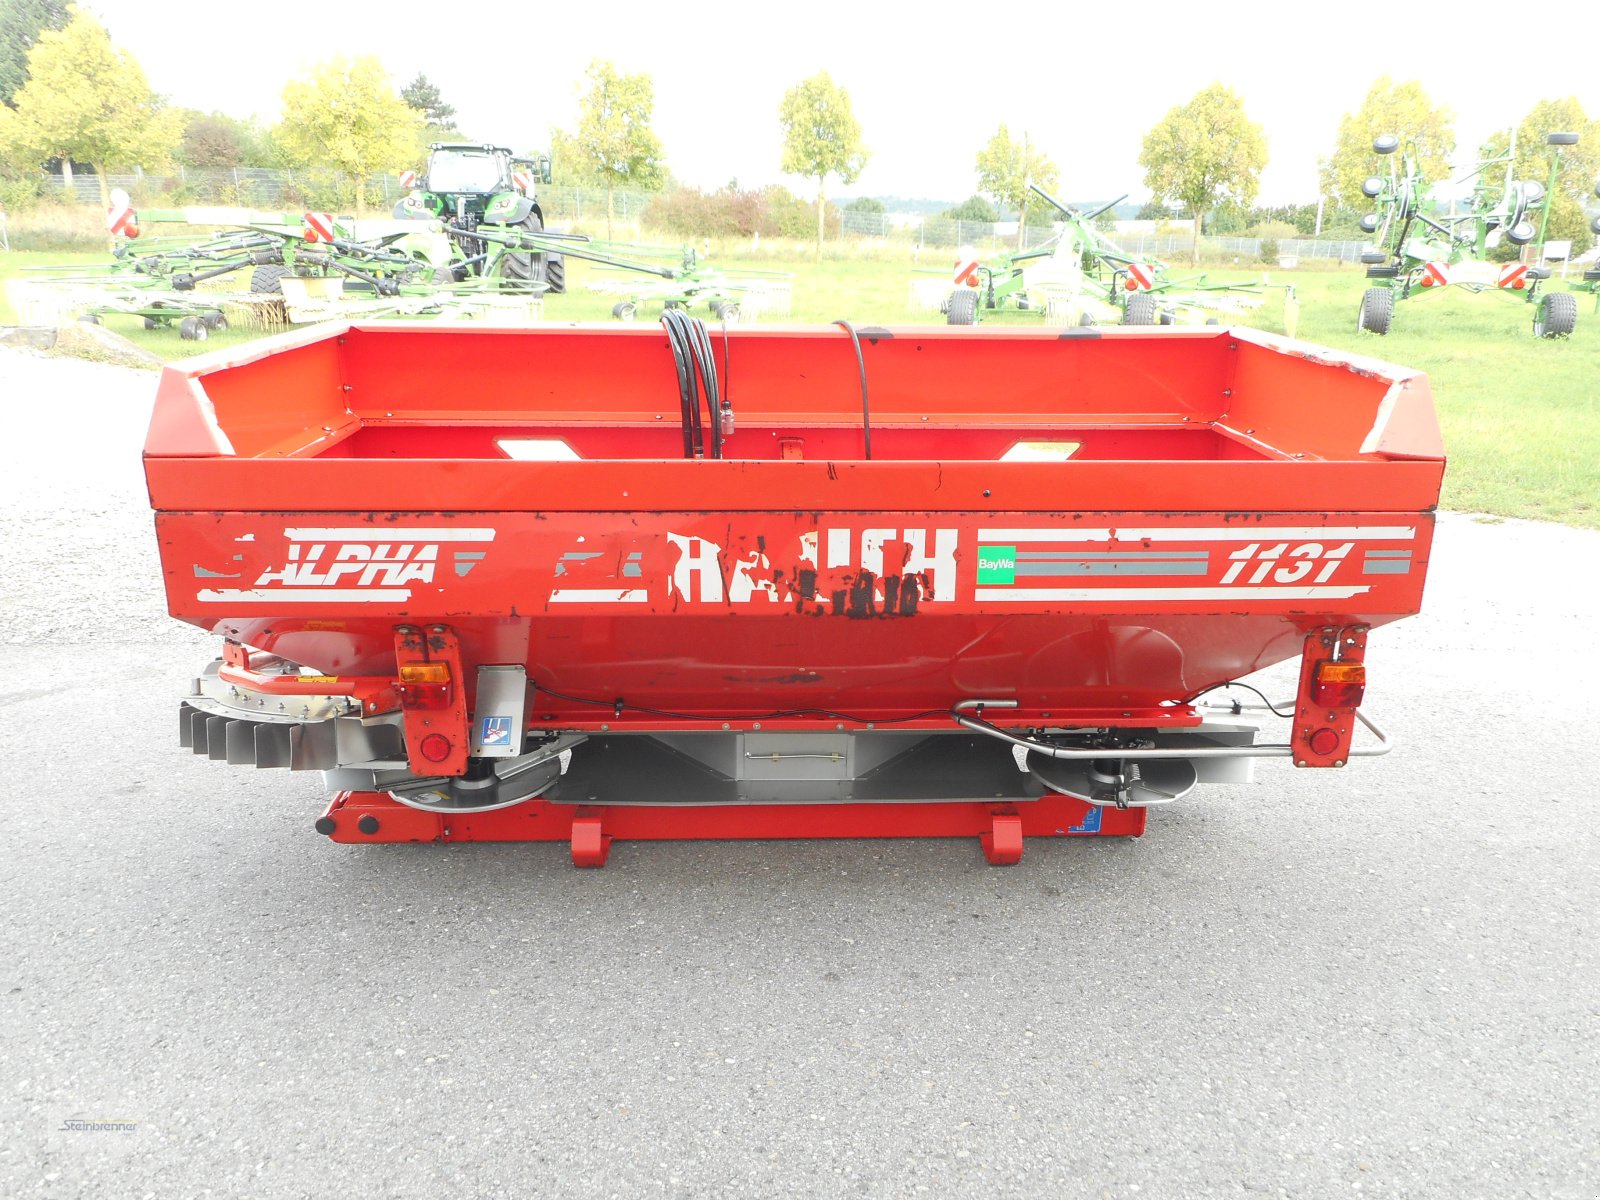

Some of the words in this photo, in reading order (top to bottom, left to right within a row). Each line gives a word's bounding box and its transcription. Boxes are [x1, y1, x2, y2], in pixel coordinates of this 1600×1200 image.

[254, 544, 439, 586] ALPHA
[979, 559, 1014, 570] BayWa
[1219, 543, 1356, 584] 1131
